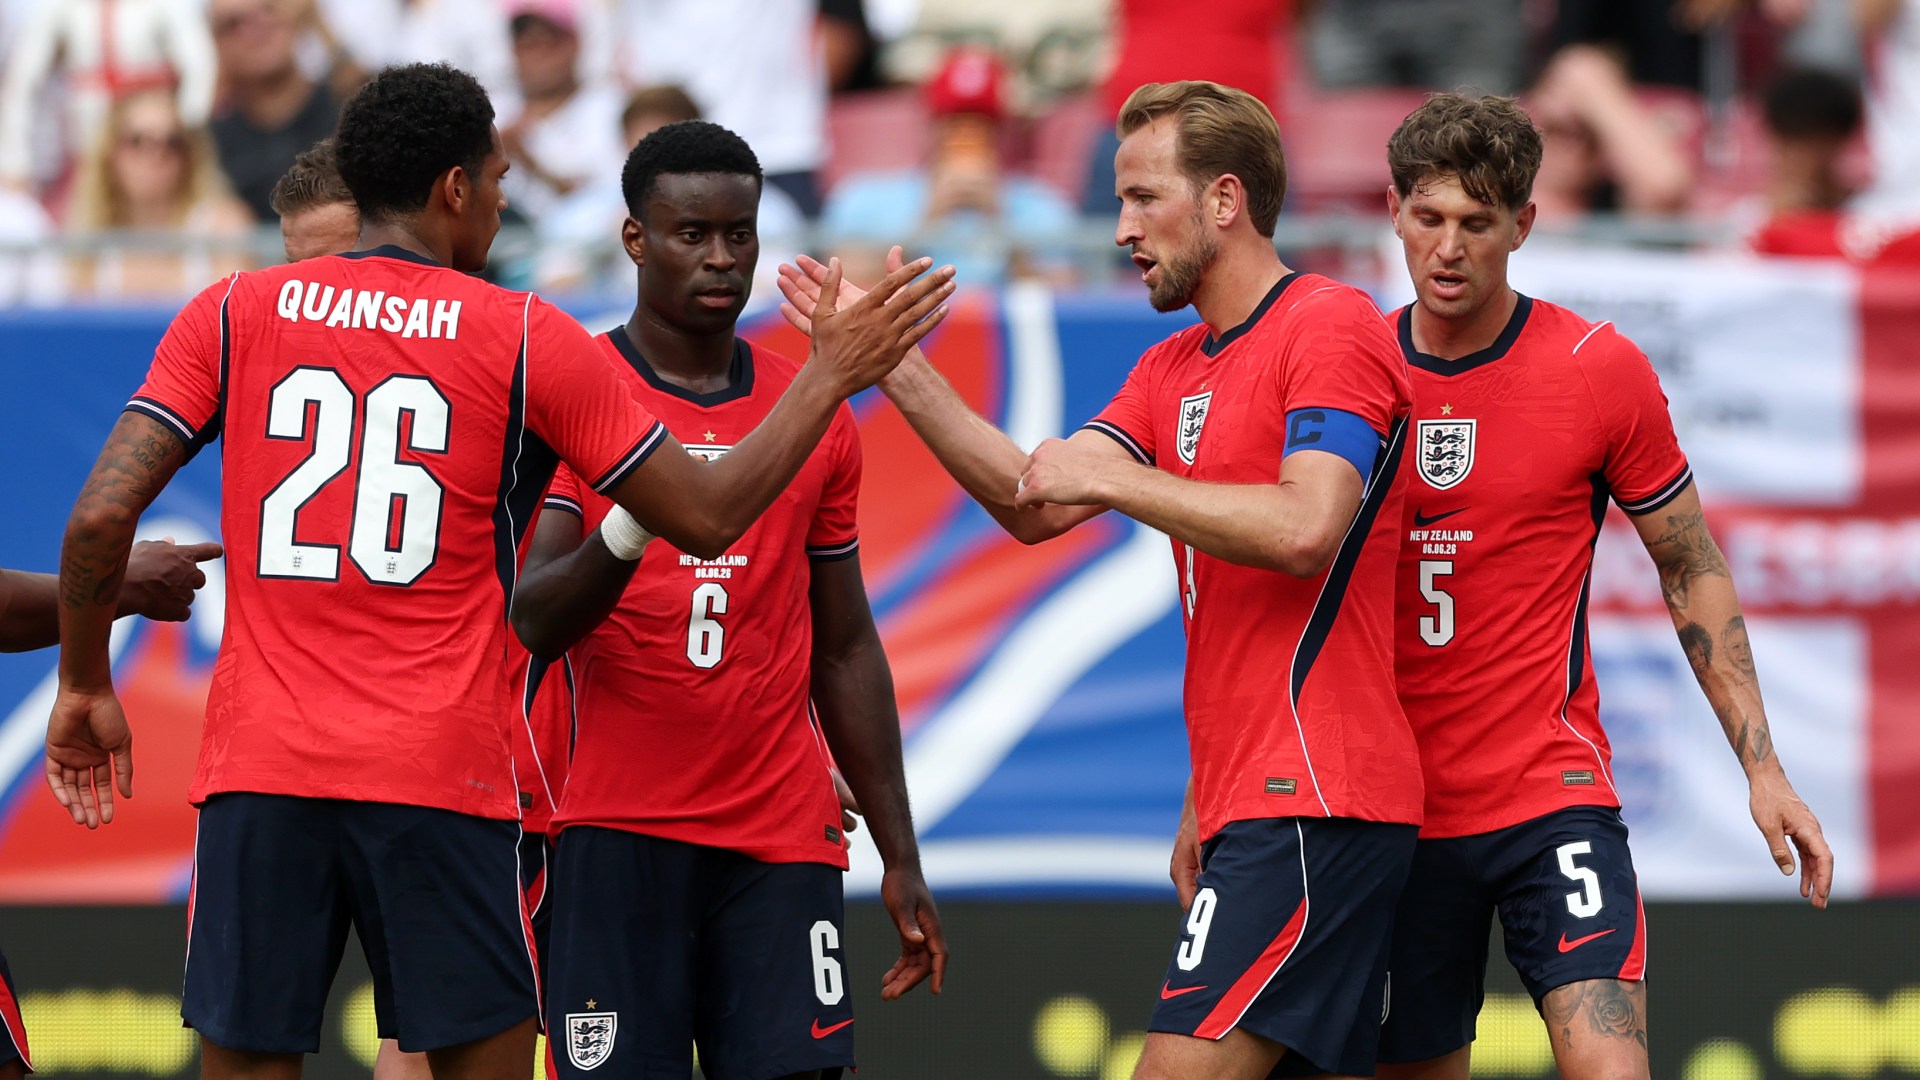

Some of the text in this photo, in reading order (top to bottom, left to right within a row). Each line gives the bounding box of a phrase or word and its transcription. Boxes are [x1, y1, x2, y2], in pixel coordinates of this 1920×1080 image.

[277, 279, 462, 340] QUANSAH
[1288, 411, 1325, 448] C
[256, 364, 453, 588] 26
[679, 554, 702, 566] NEW
[1410, 530, 1474, 541] NEW ZEALAND
[1422, 543, 1457, 554] 06.06.26
[695, 567, 731, 579] 06.06.26
[1419, 559, 1455, 647] 5
[687, 582, 728, 669] 6
[1555, 840, 1603, 918] 5
[809, 920, 844, 1006] 6
[1177, 887, 1217, 972] 9
